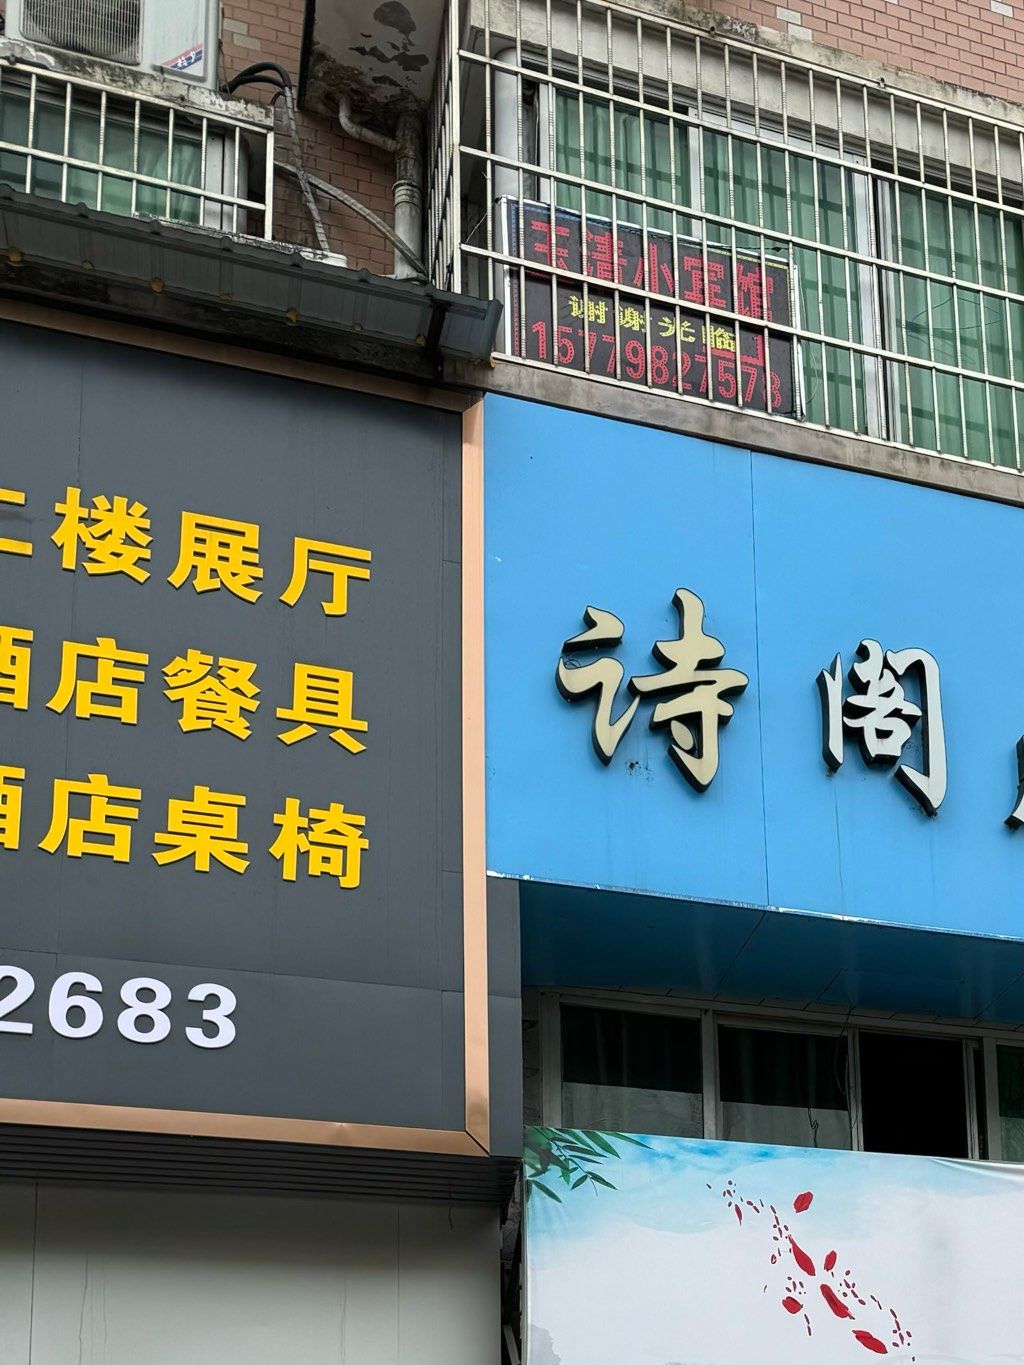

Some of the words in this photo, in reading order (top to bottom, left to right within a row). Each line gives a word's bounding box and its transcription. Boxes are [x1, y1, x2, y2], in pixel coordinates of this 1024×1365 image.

[0, 765, 369, 889] 店桌椅
[0, 965, 237, 1048] 2683
